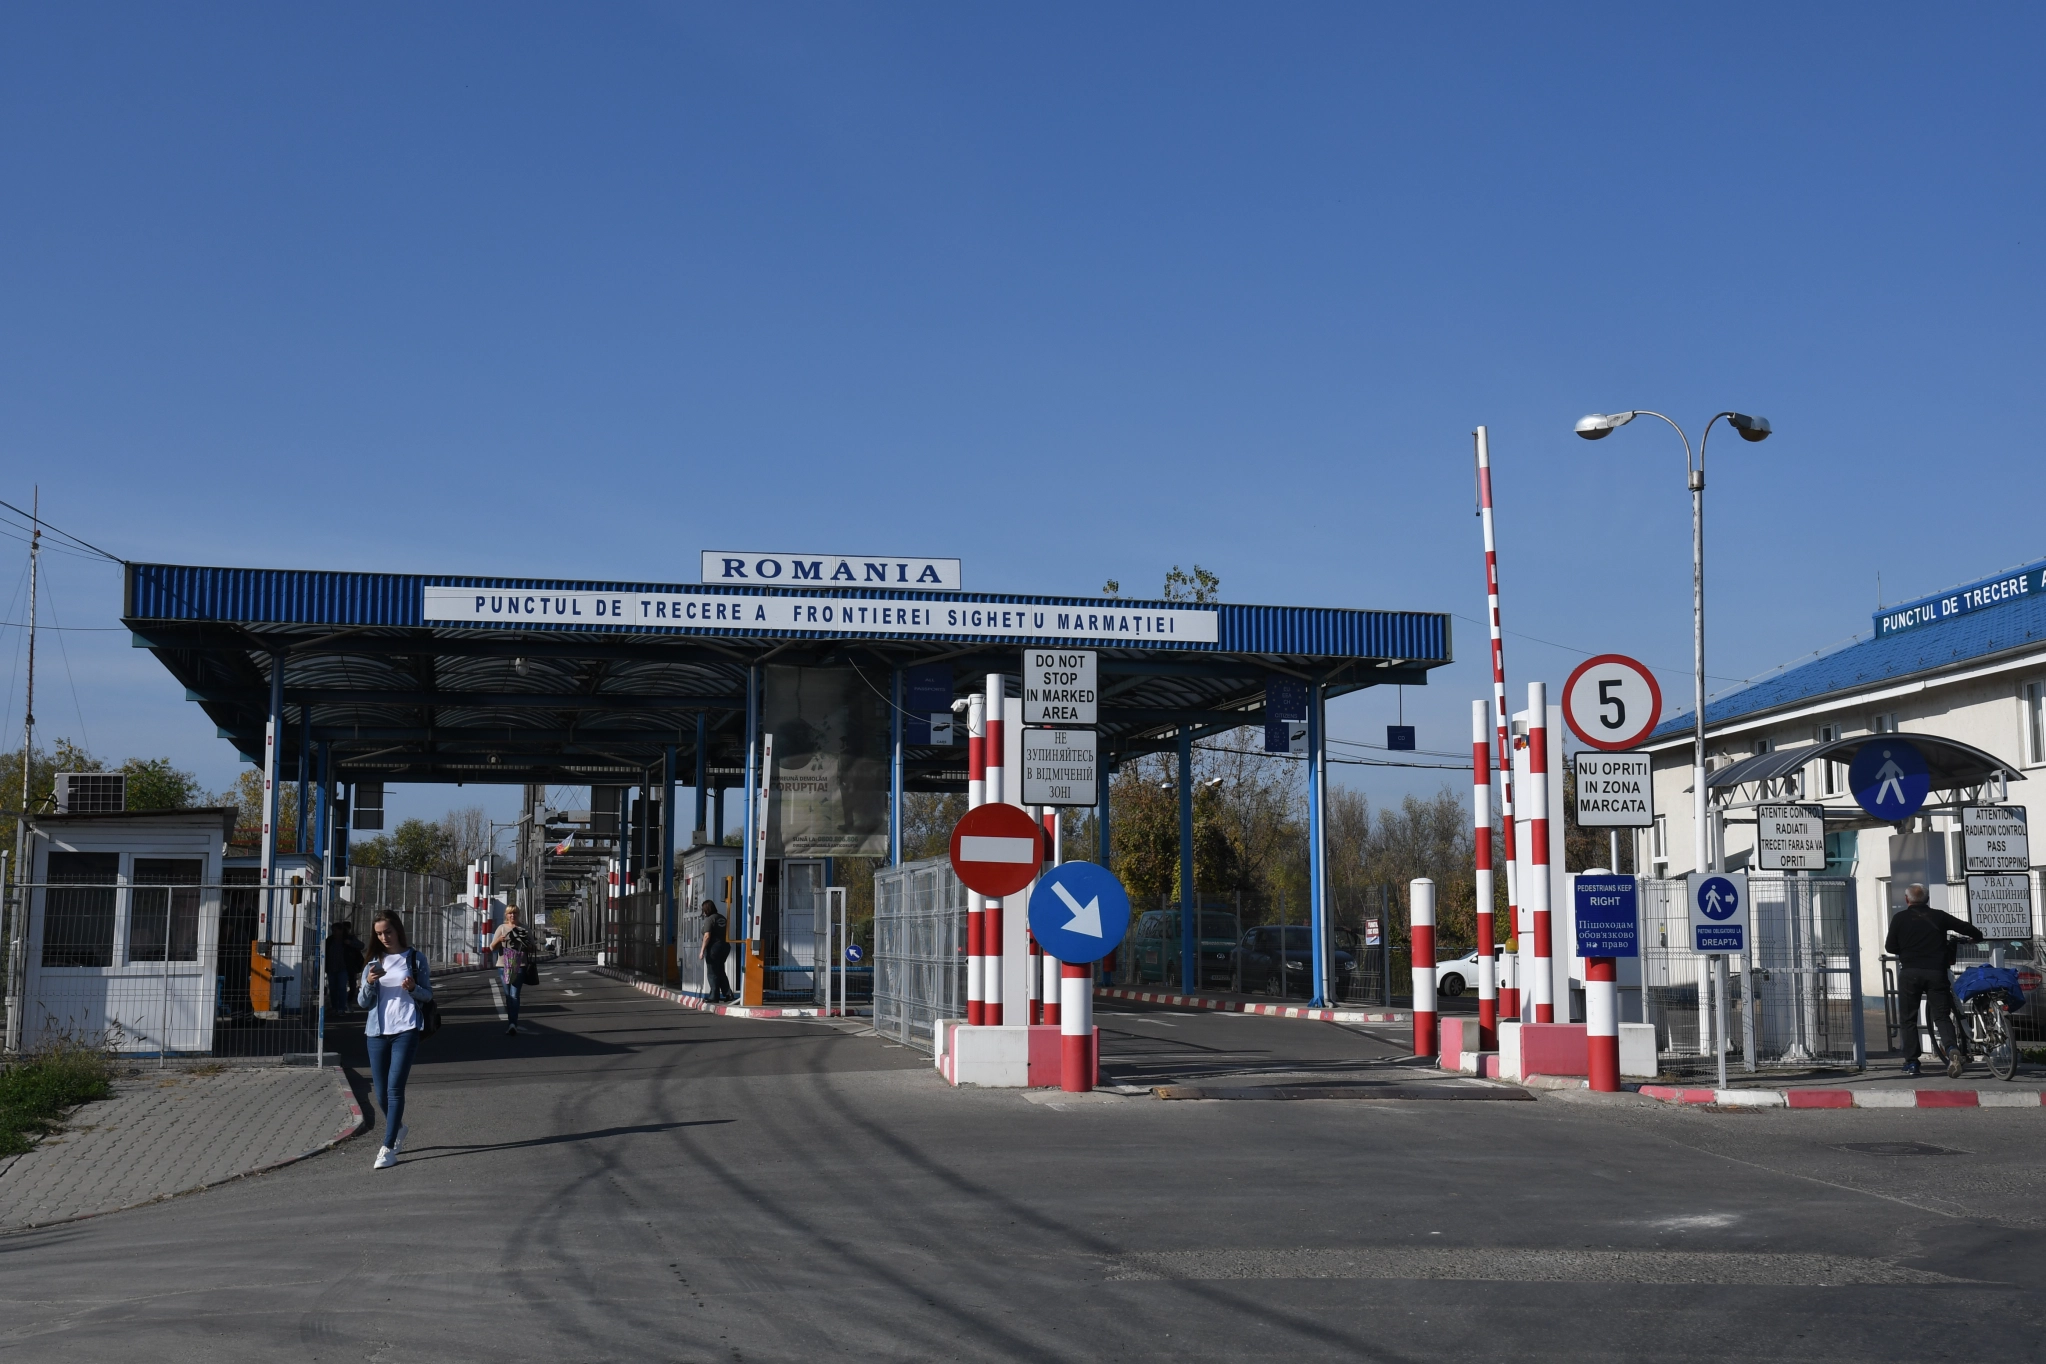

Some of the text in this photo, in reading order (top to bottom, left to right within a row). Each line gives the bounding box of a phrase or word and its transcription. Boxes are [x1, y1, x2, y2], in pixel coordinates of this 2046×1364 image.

[721, 558, 942, 583] ROMÂNIA
[1883, 604, 1936, 632] PUNCTUL
[1942, 597, 1958, 616] DE
[1964, 575, 2028, 609] TRECERE
[475, 596, 582, 616] PUNCTUL
[596, 599, 622, 617] DE
[641, 600, 742, 621] TRECERE
[754, 604, 766, 621] A
[793, 605, 930, 625] FRONTIEREI
[1057, 613, 1174, 635] MARMAȚIEI
[1036, 654, 1085, 668] DO NOT
[1043, 672, 1078, 685] STOP
[1026, 688, 1095, 703] IN MARKED
[1598, 679, 1626, 729] 5
[1042, 706, 1078, 720] AREA
[1054, 732, 1068, 744] НЕ
[1026, 747, 1094, 762] ЗУПИНЯЙТЕСЬ
[1027, 766, 1093, 782] В ВІДМІЧЕНІЙ
[1579, 762, 1647, 776] NU OPRITI
[1049, 785, 1071, 799] ЗОНІ
[1585, 781, 1641, 794] IN ZONA
[1580, 799, 1646, 812] MARCATA
[1761, 807, 1822, 818] ATENTIE CONTROL
[1976, 809, 2014, 820] ATTENTION
[1776, 823, 1808, 835] RADIATII
[1965, 825, 2026, 836] RADIATION CONTROL
[1761, 839, 1824, 851] TRECETI FARA SA VA
[1987, 841, 2006, 852] PASS
[1780, 855, 1806, 867] OPRITI
[1968, 856, 2027, 868] WITHOUT STOPPING
[1984, 877, 2014, 887] УВАГА
[1970, 888, 2029, 901] РАДІАЦІЙНИЙ
[1590, 896, 1621, 906] RIGHT
[1978, 902, 2024, 913] КОНТРОЛЬ
[1579, 920, 1634, 929] Пішоходам
[1976, 913, 2027, 925] ПРОХОДЬТЕ
[1578, 930, 1634, 939] обов'язково
[1991, 926, 2031, 937] ЗУПИНКИ
[1602, 941, 1629, 950] право
[1702, 938, 1738, 946] DREAPTA
